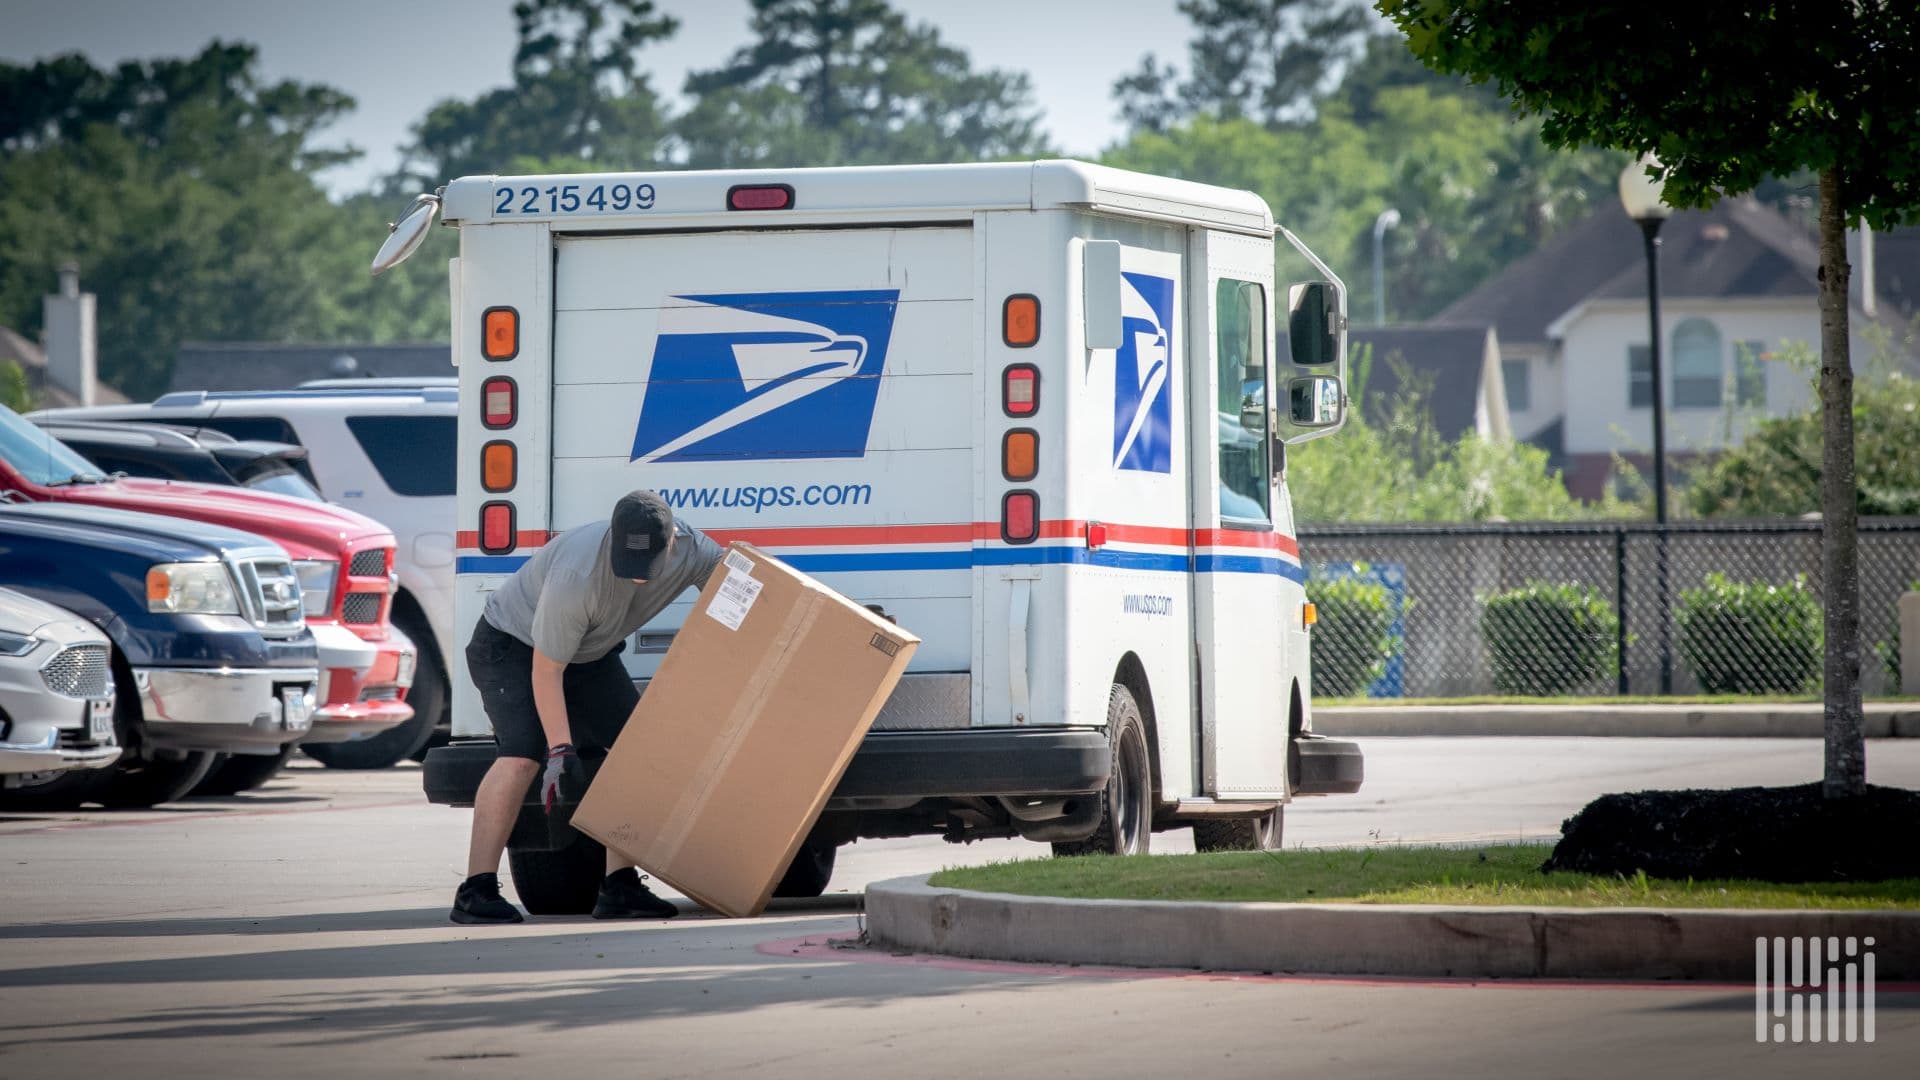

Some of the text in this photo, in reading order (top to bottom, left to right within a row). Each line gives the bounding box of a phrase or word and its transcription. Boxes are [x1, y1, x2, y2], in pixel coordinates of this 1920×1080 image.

[495, 184, 655, 213] 2215499
[649, 484, 872, 513] ww.usps.com
[1123, 593, 1173, 621] www.usps.com
